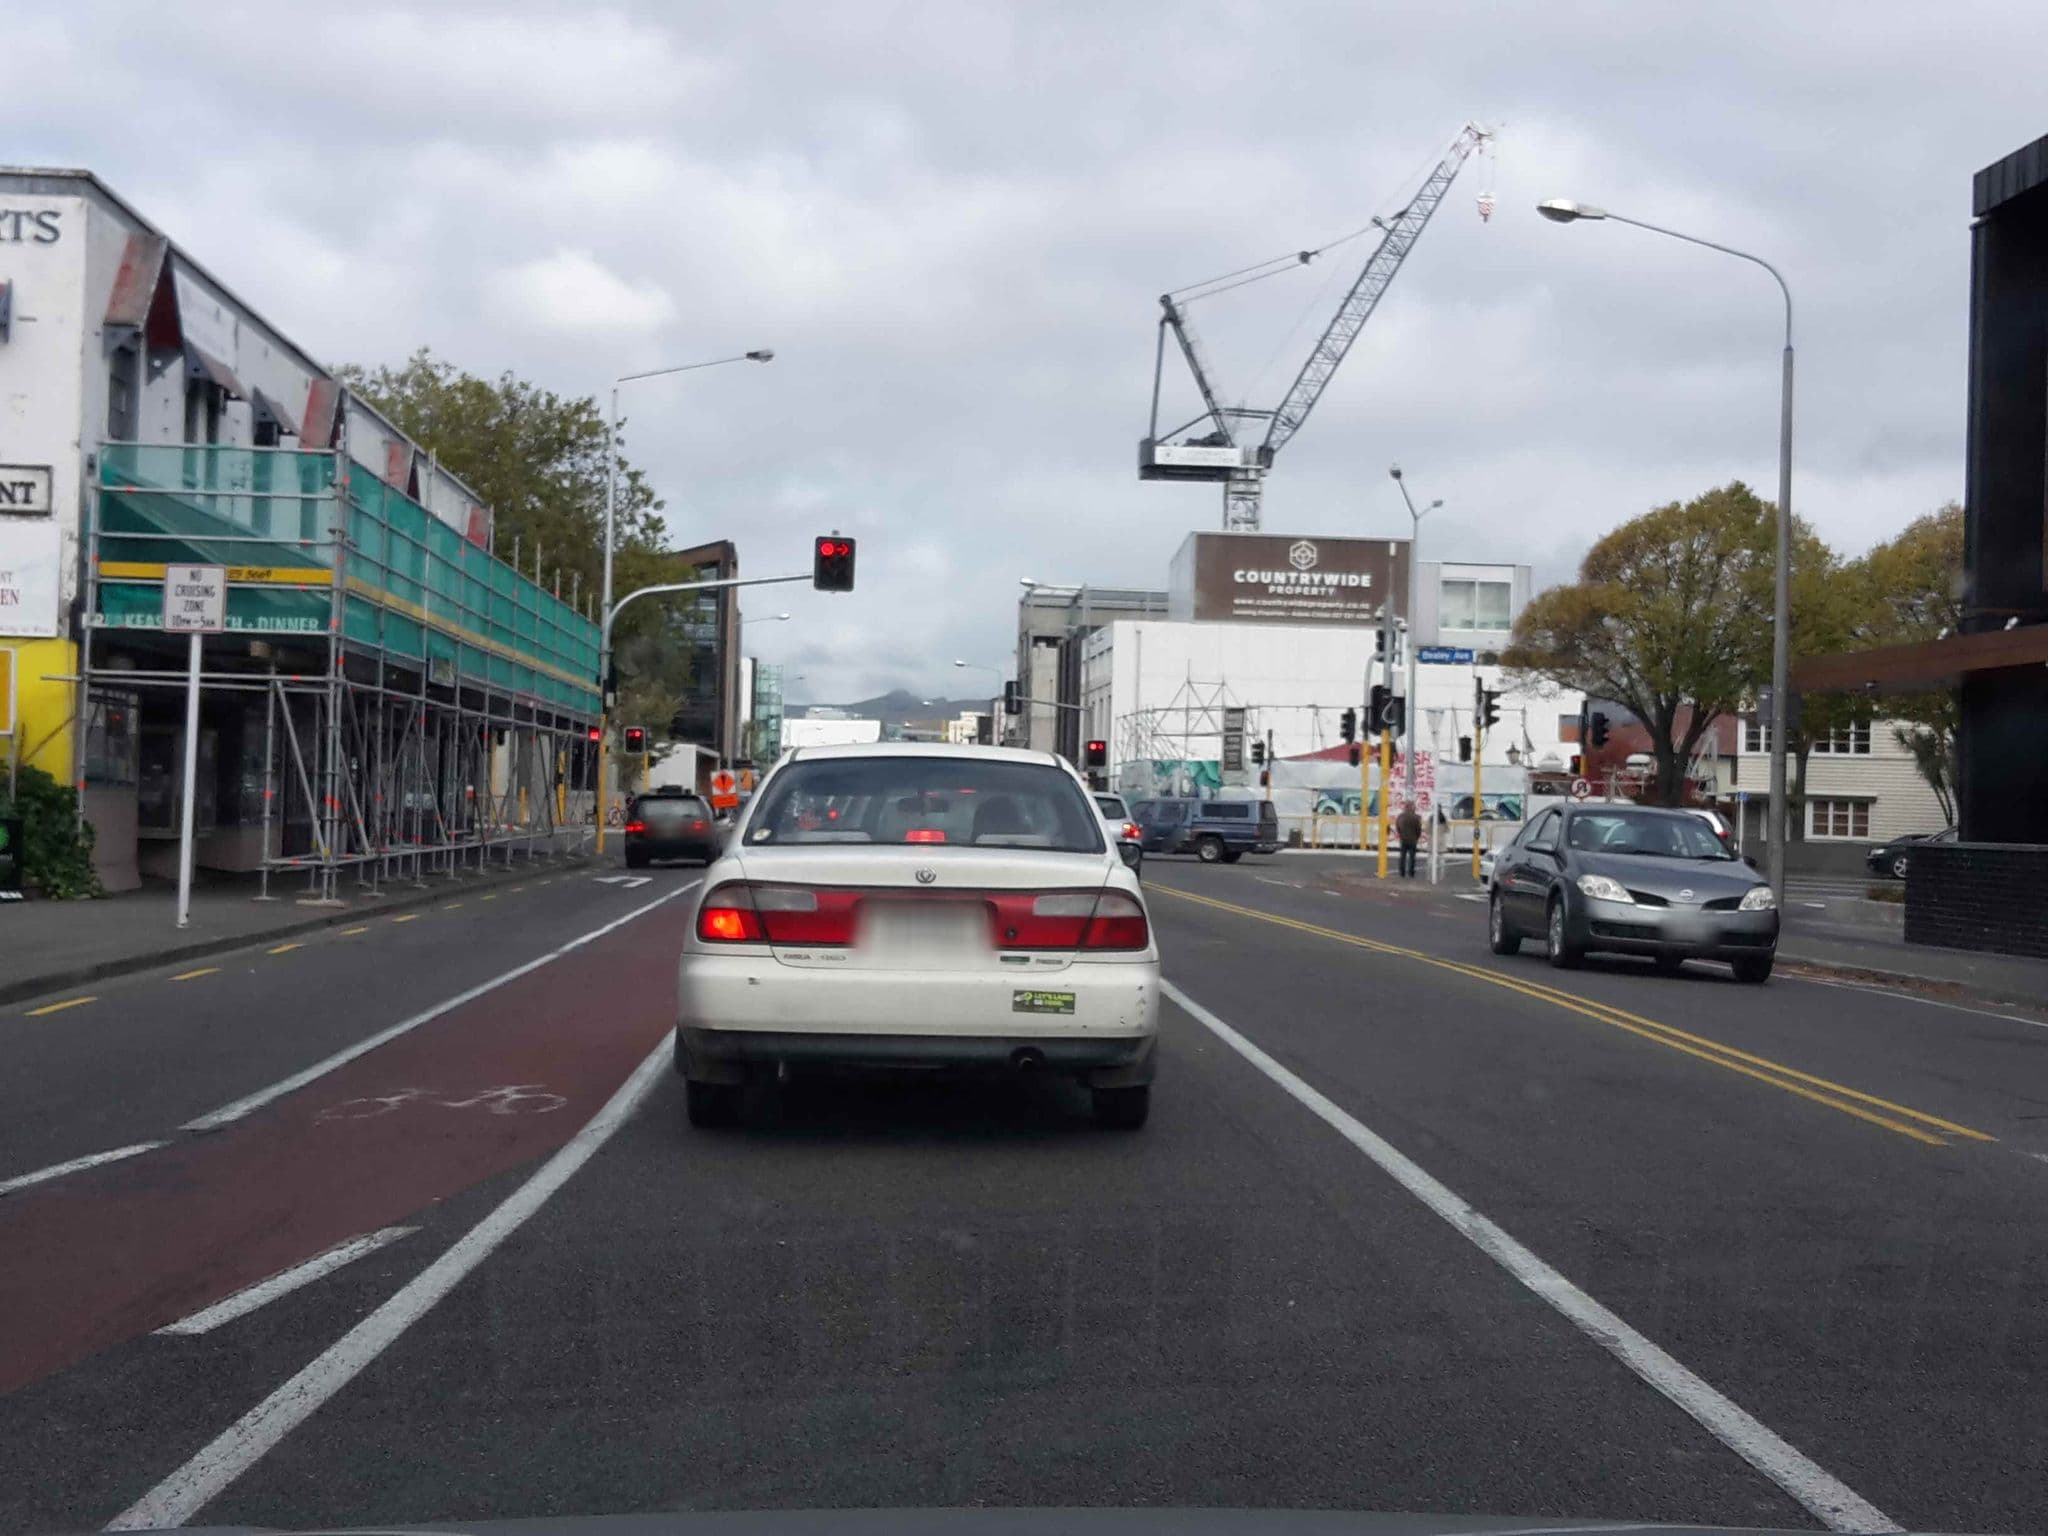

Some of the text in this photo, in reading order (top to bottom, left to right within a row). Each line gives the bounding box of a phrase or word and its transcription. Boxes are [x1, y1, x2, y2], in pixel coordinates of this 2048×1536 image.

[190, 569, 202, 582] NO
[1233, 569, 1372, 587] COUNTRYWIDE
[174, 584, 216, 598] CRUISING
[1268, 585, 1335, 596] PROPERTY
[183, 599, 205, 613] ZONE
[257, 615, 319, 630] DINNER
